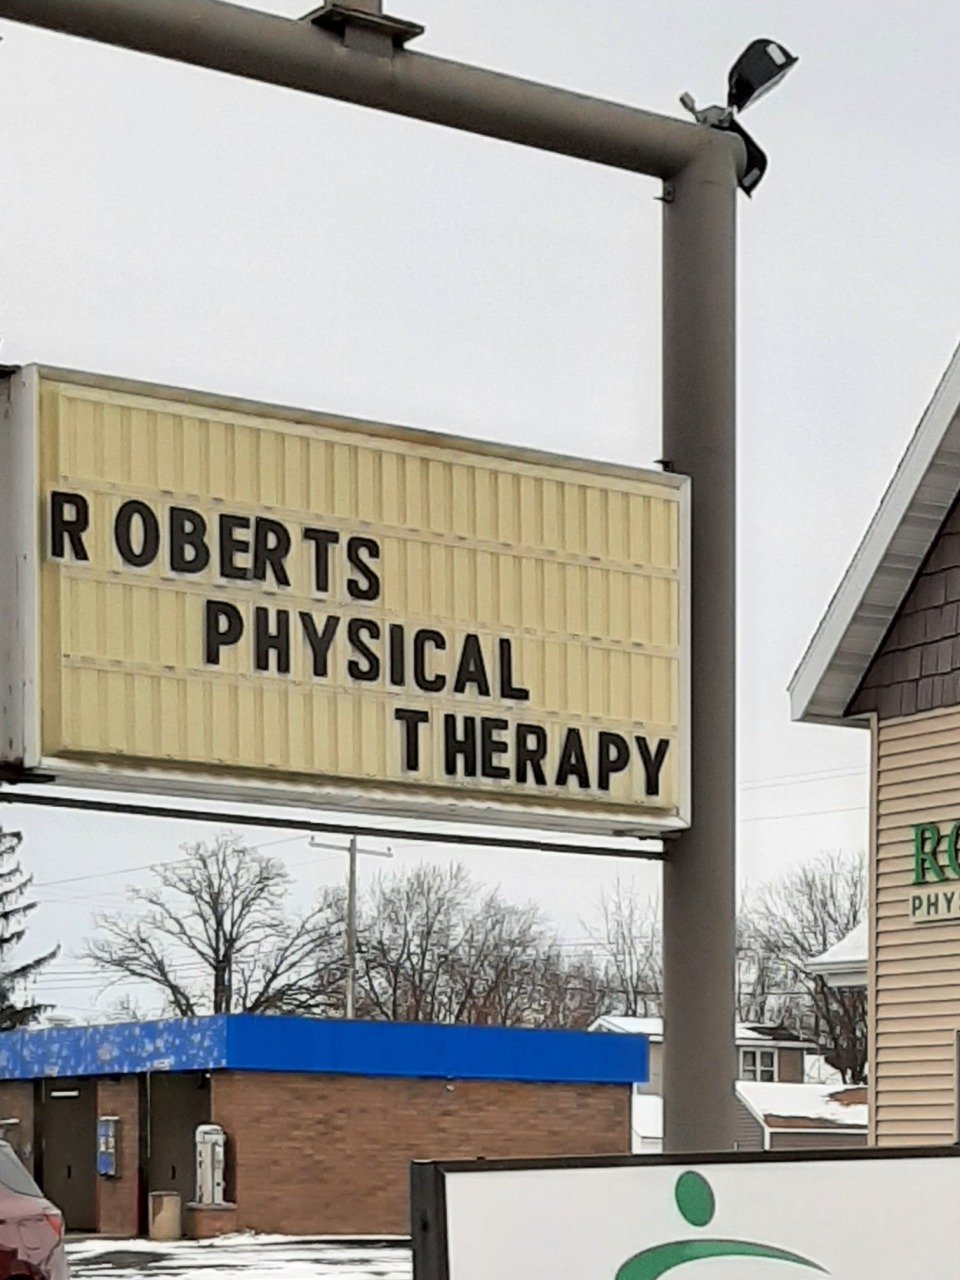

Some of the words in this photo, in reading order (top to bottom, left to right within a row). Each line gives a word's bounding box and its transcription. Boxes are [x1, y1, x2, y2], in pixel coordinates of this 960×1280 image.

[50, 490, 381, 601] ROBERTS
[205, 600, 530, 700] PHYSICAL
[395, 708, 670, 795] THERAPY
